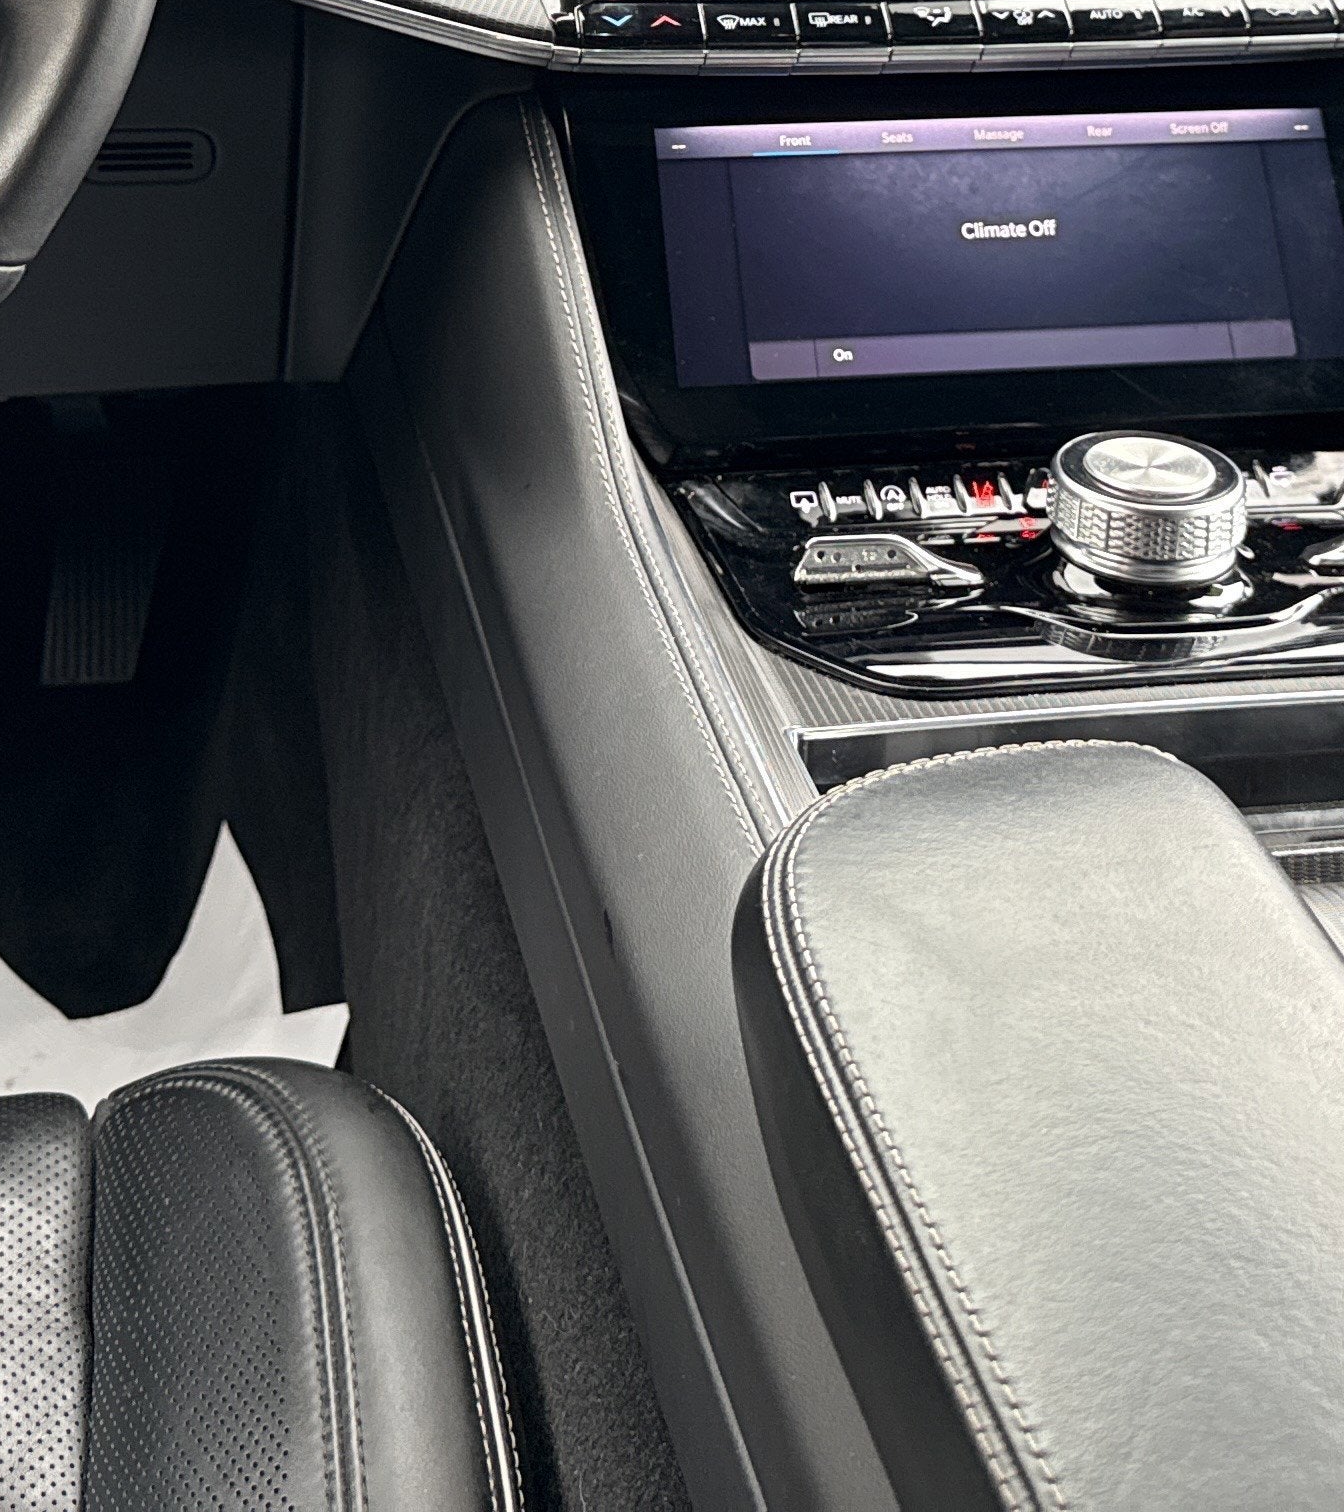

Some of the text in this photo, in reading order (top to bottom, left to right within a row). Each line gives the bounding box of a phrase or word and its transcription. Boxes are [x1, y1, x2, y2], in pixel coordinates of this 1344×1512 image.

[828, 15, 859, 25] REAR
[1089, 9, 1124, 20] AUTO
[739, 16, 767, 27] MAX
[1086, 125, 1113, 138] Rear
[1169, 121, 1229, 135] Screen Off
[779, 135, 812, 148] Front
[881, 131, 914, 144] Seats
[973, 128, 1025, 142] Massage
[961, 219, 1057, 240] Climate Off
[833, 348, 854, 362] On
